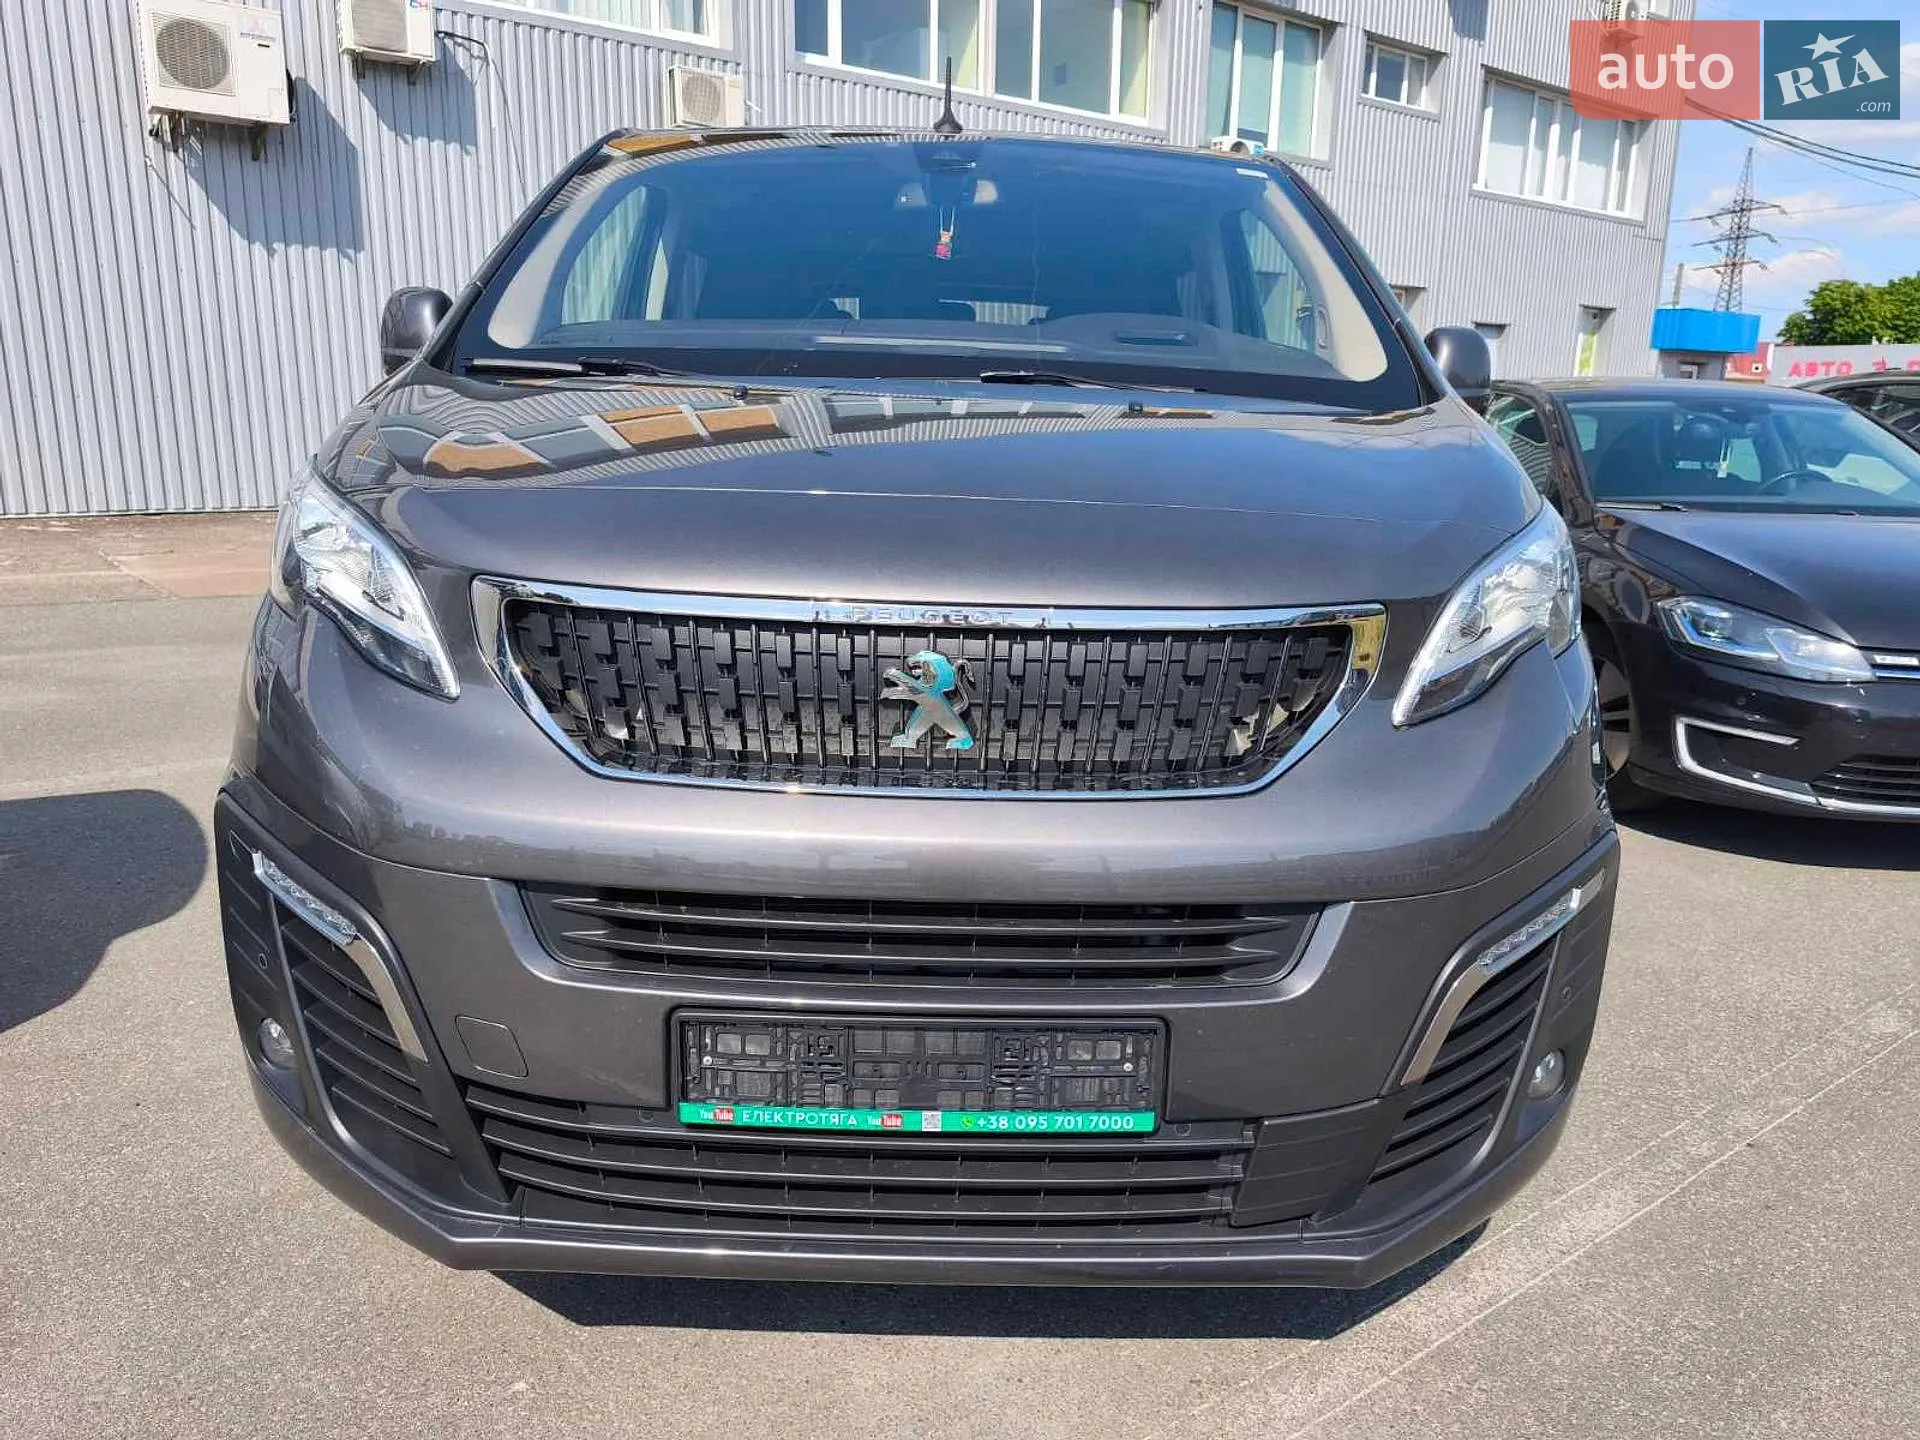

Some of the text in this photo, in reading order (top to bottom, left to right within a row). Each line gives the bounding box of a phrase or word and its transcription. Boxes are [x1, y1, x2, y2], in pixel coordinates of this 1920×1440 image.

[742, 1110, 858, 1126] ЕЛЕКТРОТЯГА
[976, 1116, 1009, 1129] +38
[1015, 1116, 1047, 1130] 095
[1054, 1116, 1082, 1130] 701
[1088, 1116, 1134, 1130] 7000
